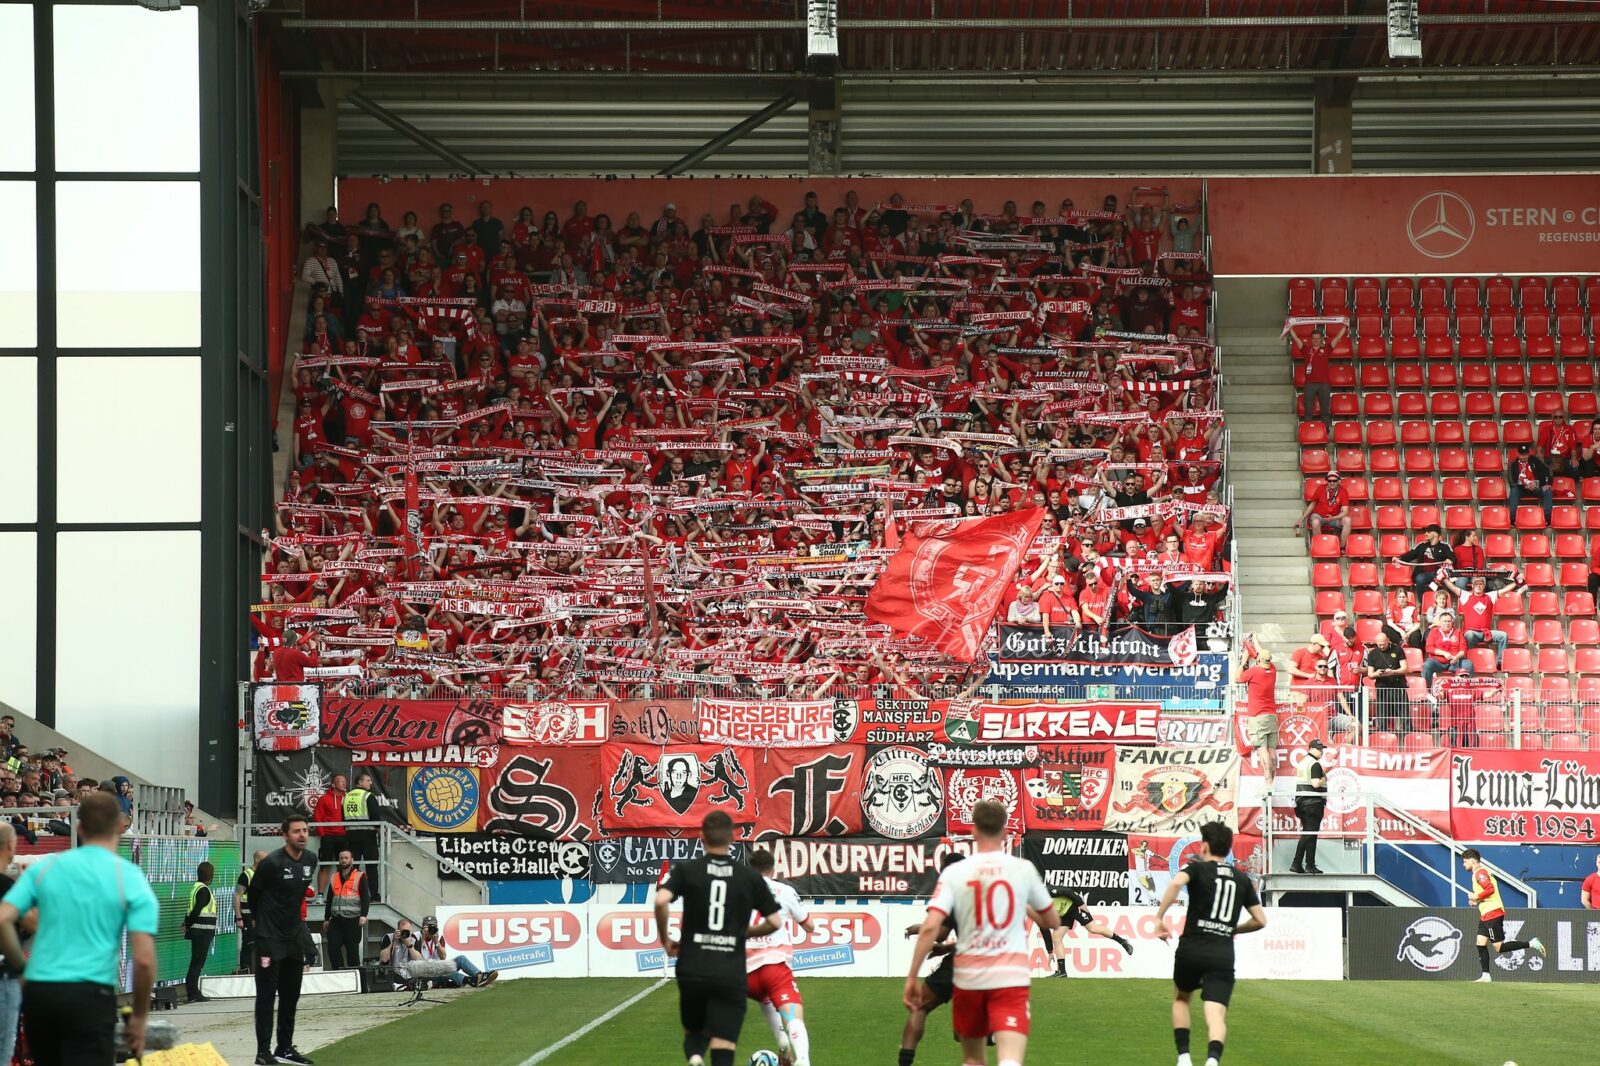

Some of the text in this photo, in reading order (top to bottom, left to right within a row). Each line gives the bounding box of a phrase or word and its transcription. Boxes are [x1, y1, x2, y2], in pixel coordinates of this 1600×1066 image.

[1486, 208, 1600, 226] STERN C
[974, 311, 1027, 320] HFC-FANKURVE
[822, 356, 881, 364] HFC-FANKURVE
[607, 451, 633, 459] CHEMIE
[544, 460, 599, 470] HFC-FANKURVE
[801, 483, 865, 493] CHEMIE HALLE
[540, 513, 597, 523] HFC-FANKURVE
[523, 543, 584, 551] HFC-FANKURVE
[325, 561, 382, 571] HFC-FANKURVE
[876, 700, 929, 710] SEKTION
[320, 701, 442, 745] Köthen
[862, 711, 942, 723] MANSFELD
[982, 708, 1158, 738] SURREALE
[867, 728, 935, 743] SÜDHARZ
[926, 742, 1024, 766] Petersberg
[1119, 749, 1232, 765] FANCLUB
[1321, 746, 1432, 772] CHEMIE
[1082, 767, 1103, 778] HFC
[990, 778, 1002, 786] FC
[1120, 780, 1133, 791] 19
[346, 804, 358, 813] 658
[1484, 814, 1595, 840] seit 1984
[1042, 838, 1128, 856] DOMFALKEN
[510, 856, 561, 875] Halle
[626, 867, 661, 876] No Su
[860, 876, 909, 892] Halle
[1043, 869, 1129, 889] MERSEBURG
[1134, 887, 1142, 904] 2
[1210, 878, 1236, 923] 10
[708, 879, 727, 931] 8
[966, 879, 1015, 931] 10
[457, 917, 571, 945] FUSSL
[790, 917, 872, 945] USSL
[1263, 939, 1306, 950] HAHN
[491, 949, 546, 966] Modestraße
[793, 951, 847, 965] Modestraße
